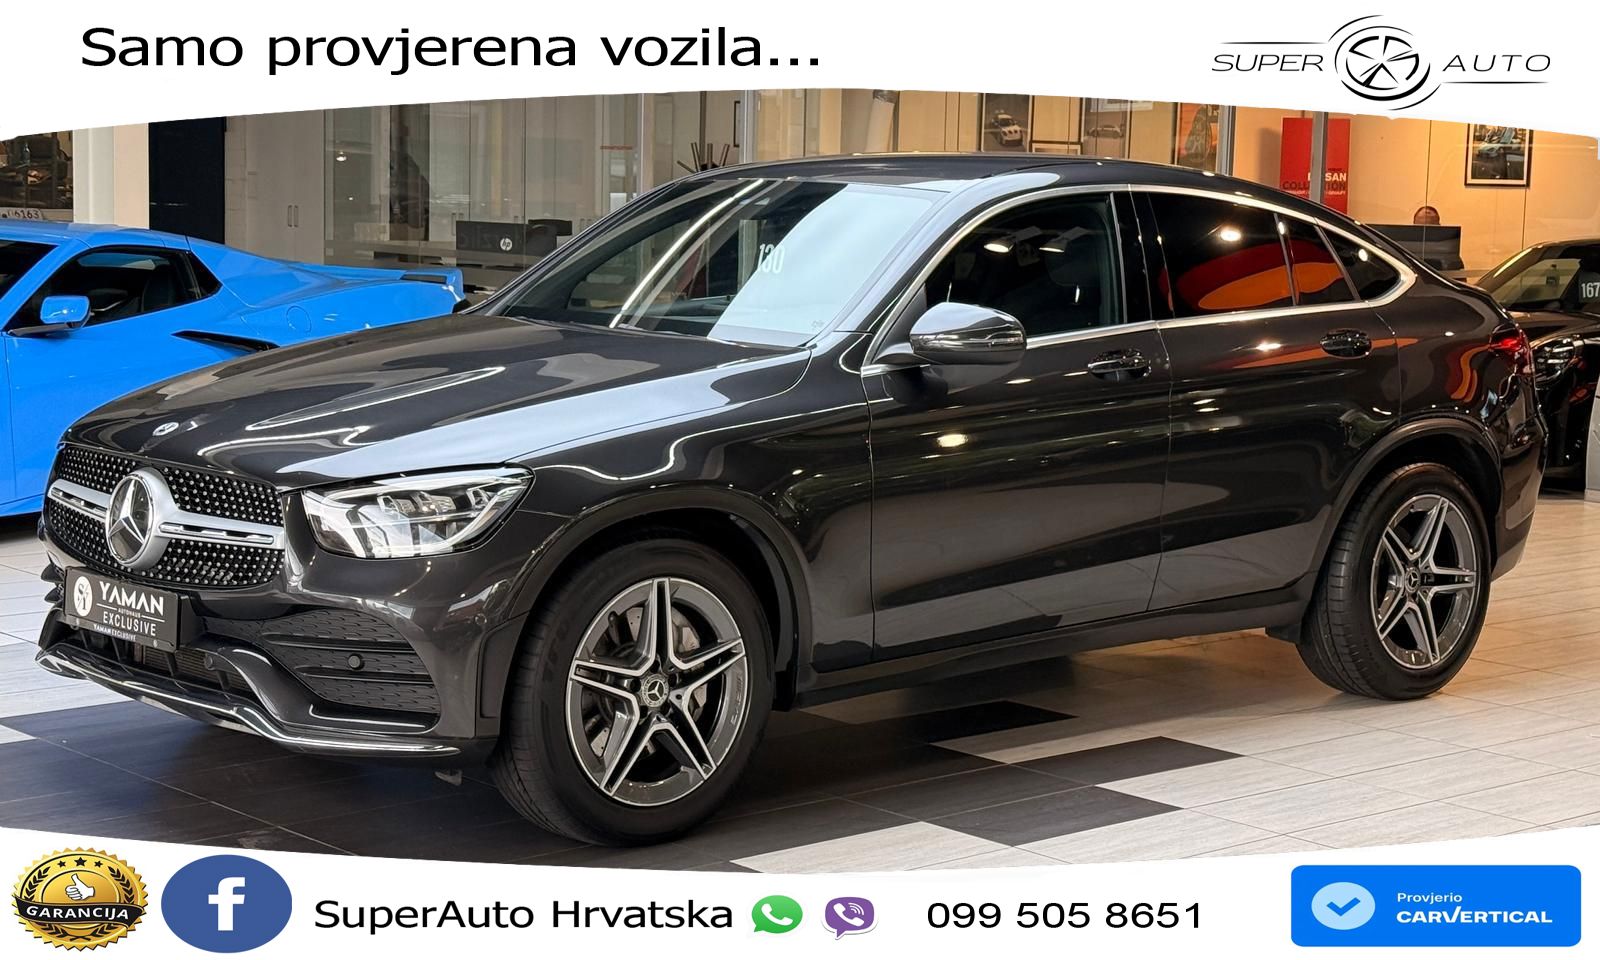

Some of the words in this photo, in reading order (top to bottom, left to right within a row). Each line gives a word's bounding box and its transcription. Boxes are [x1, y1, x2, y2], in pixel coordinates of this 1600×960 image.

[1581, 281, 1600, 298] 167
[99, 580, 164, 616] YAMAN
[103, 610, 157, 637] EXCLUSIVE
